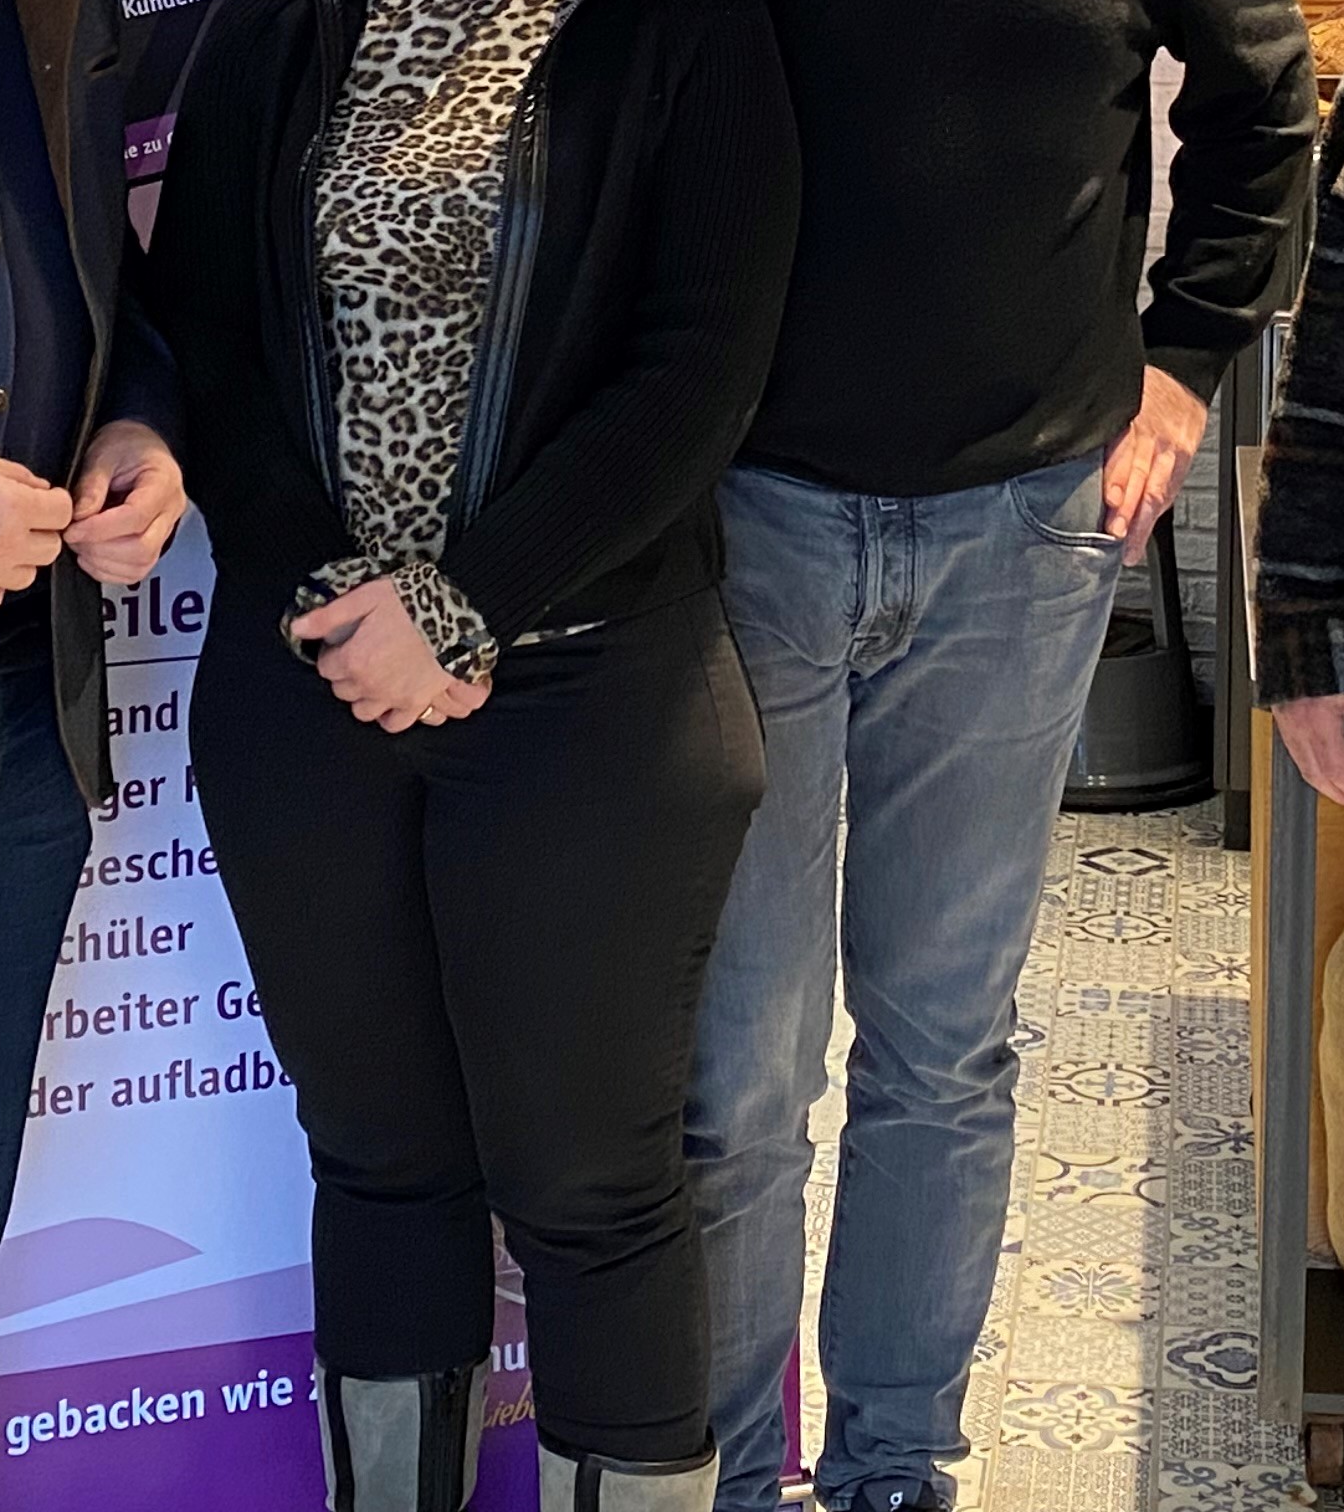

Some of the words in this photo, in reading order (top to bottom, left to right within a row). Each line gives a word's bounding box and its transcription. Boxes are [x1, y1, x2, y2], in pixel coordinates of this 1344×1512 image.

[142, 138, 163, 155] zu
[56, 916, 194, 965] chüler
[45, 991, 200, 1041] rbeiter
[5, 1387, 205, 1456] gebacken
[221, 1368, 293, 1414] wie
